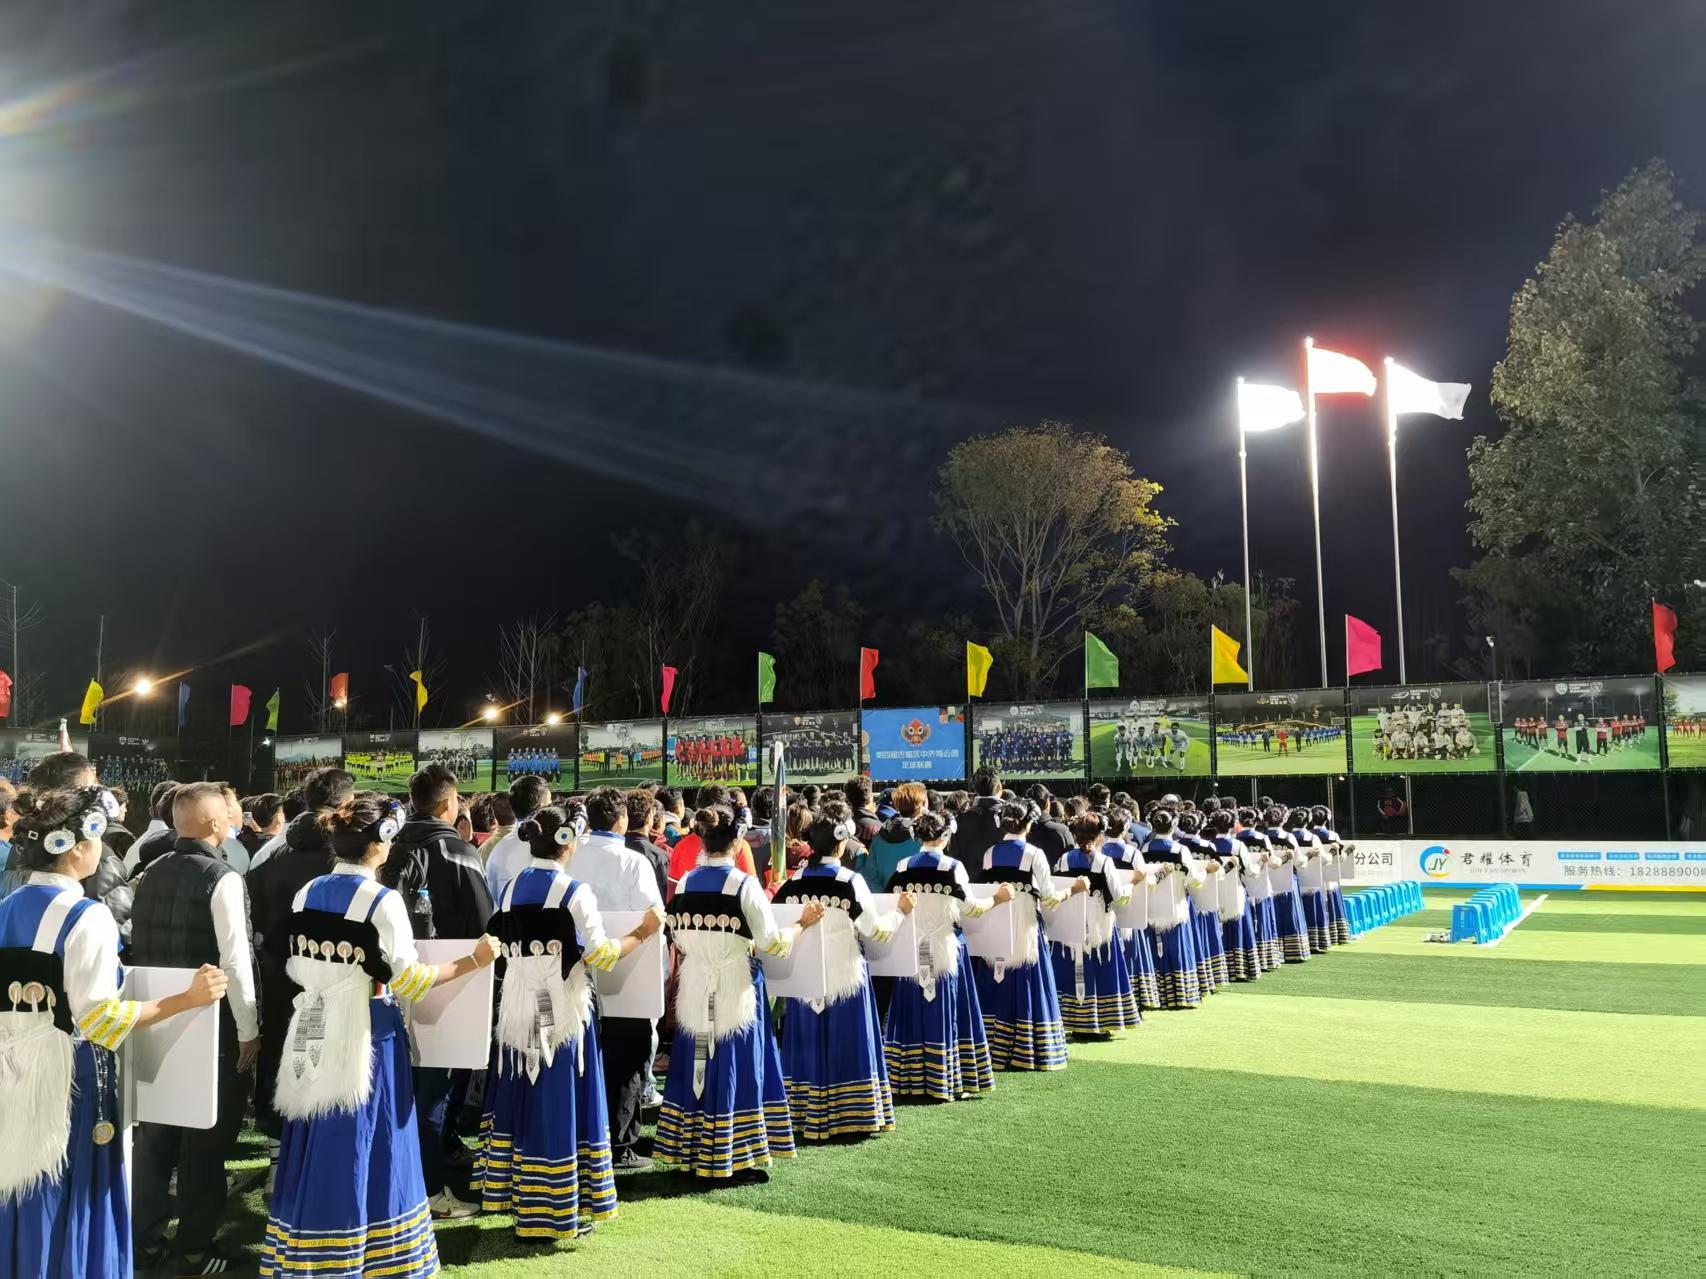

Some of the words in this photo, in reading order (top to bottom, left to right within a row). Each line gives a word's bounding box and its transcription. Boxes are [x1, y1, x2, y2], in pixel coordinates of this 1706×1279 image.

[1355, 852, 1392, 865] 分公司
[1460, 851, 1533, 867] 君耀体育
